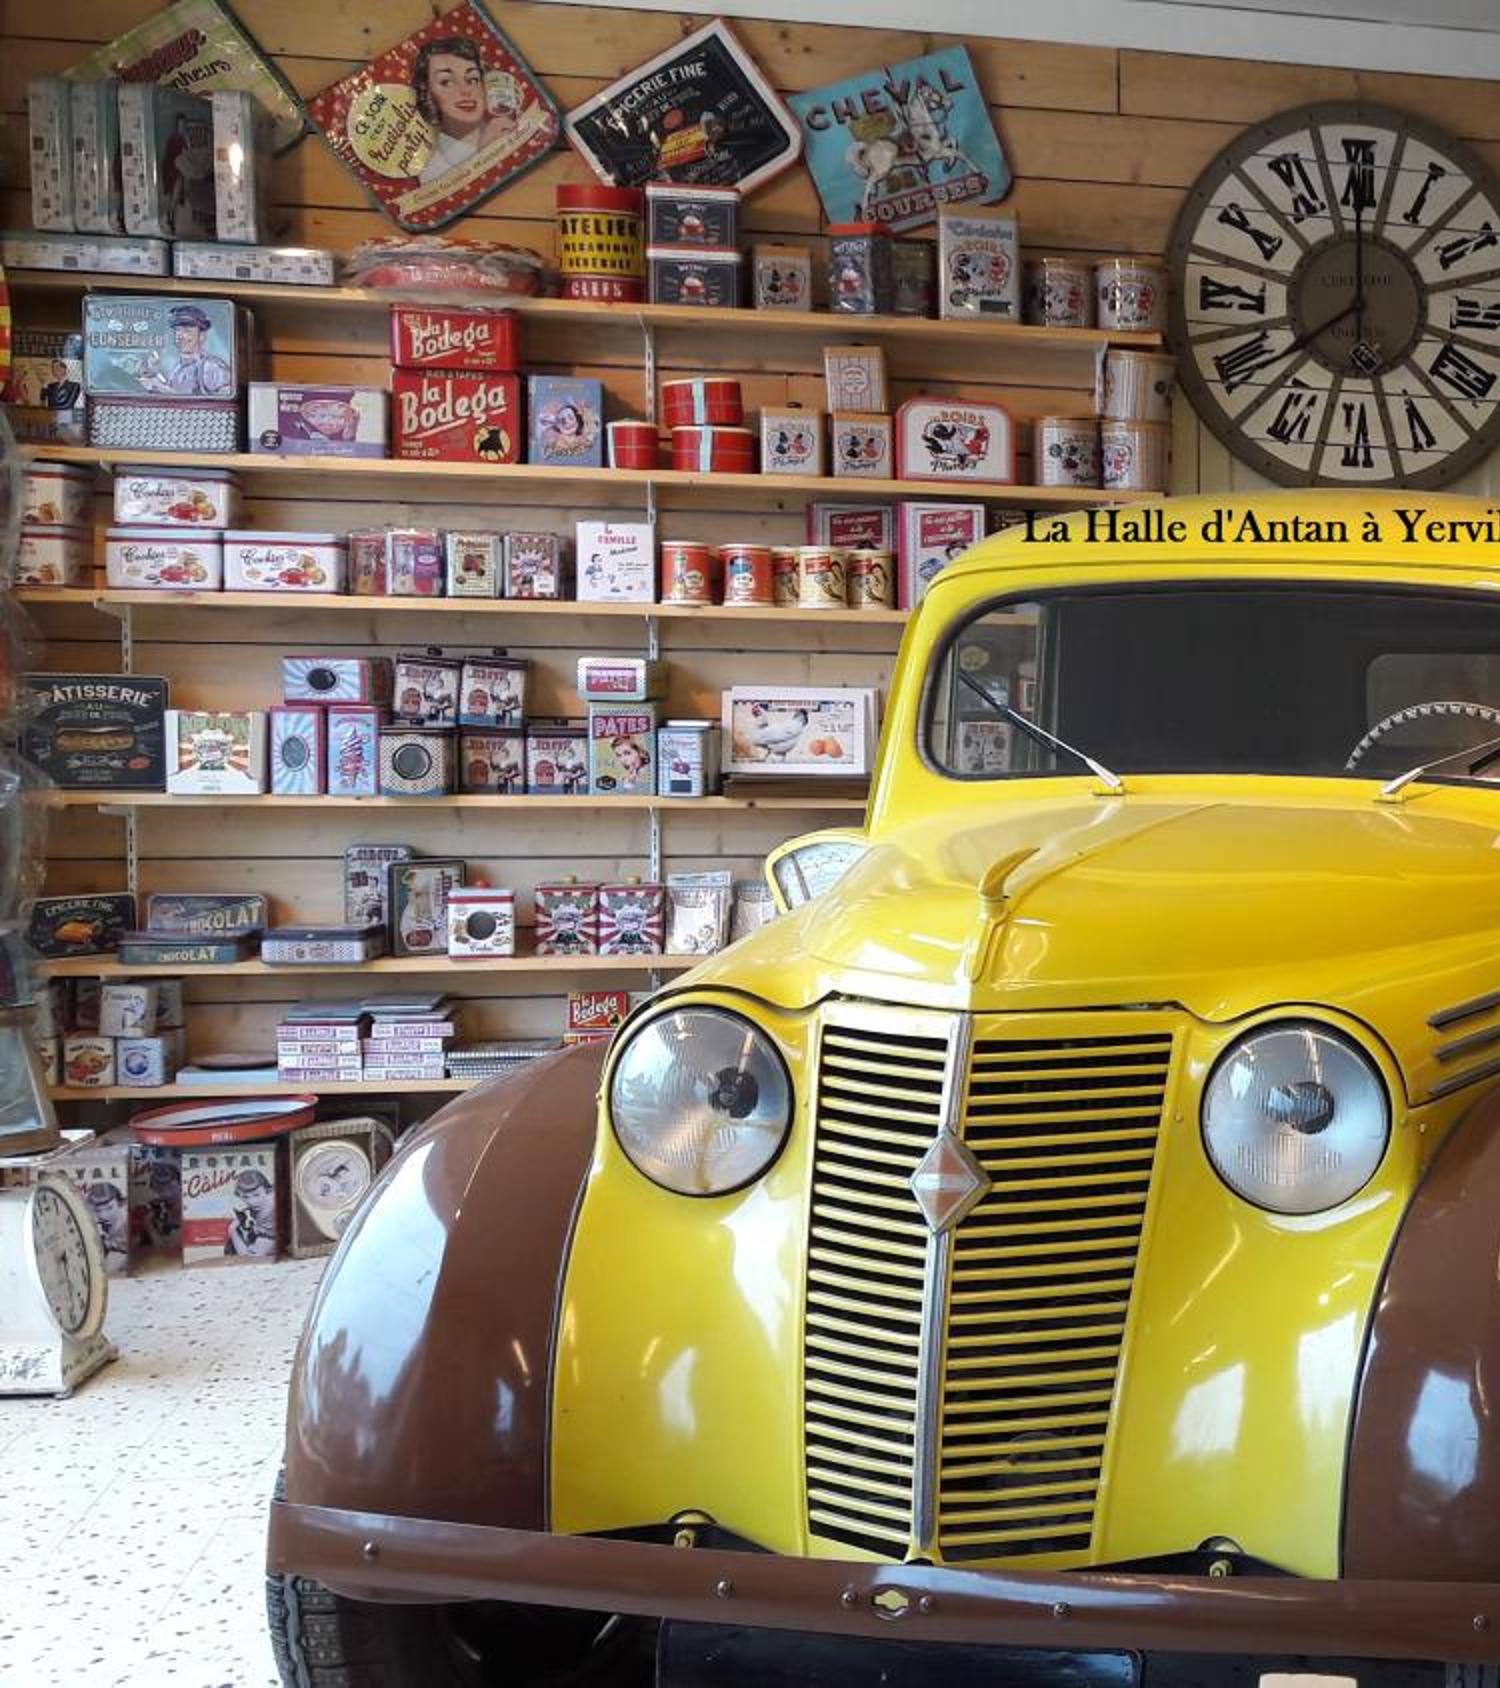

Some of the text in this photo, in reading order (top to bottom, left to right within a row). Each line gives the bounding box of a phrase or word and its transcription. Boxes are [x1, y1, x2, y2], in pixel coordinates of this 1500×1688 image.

[806, 64, 965, 130] CHEVAL
[411, 319, 489, 358] Bodega
[422, 378, 440, 404] la
[400, 380, 505, 435] Bodega
[572, 995, 617, 1022] Bodega
[190, 1154, 265, 1169] ROYAL
[187, 1170, 238, 1198] Câlin
